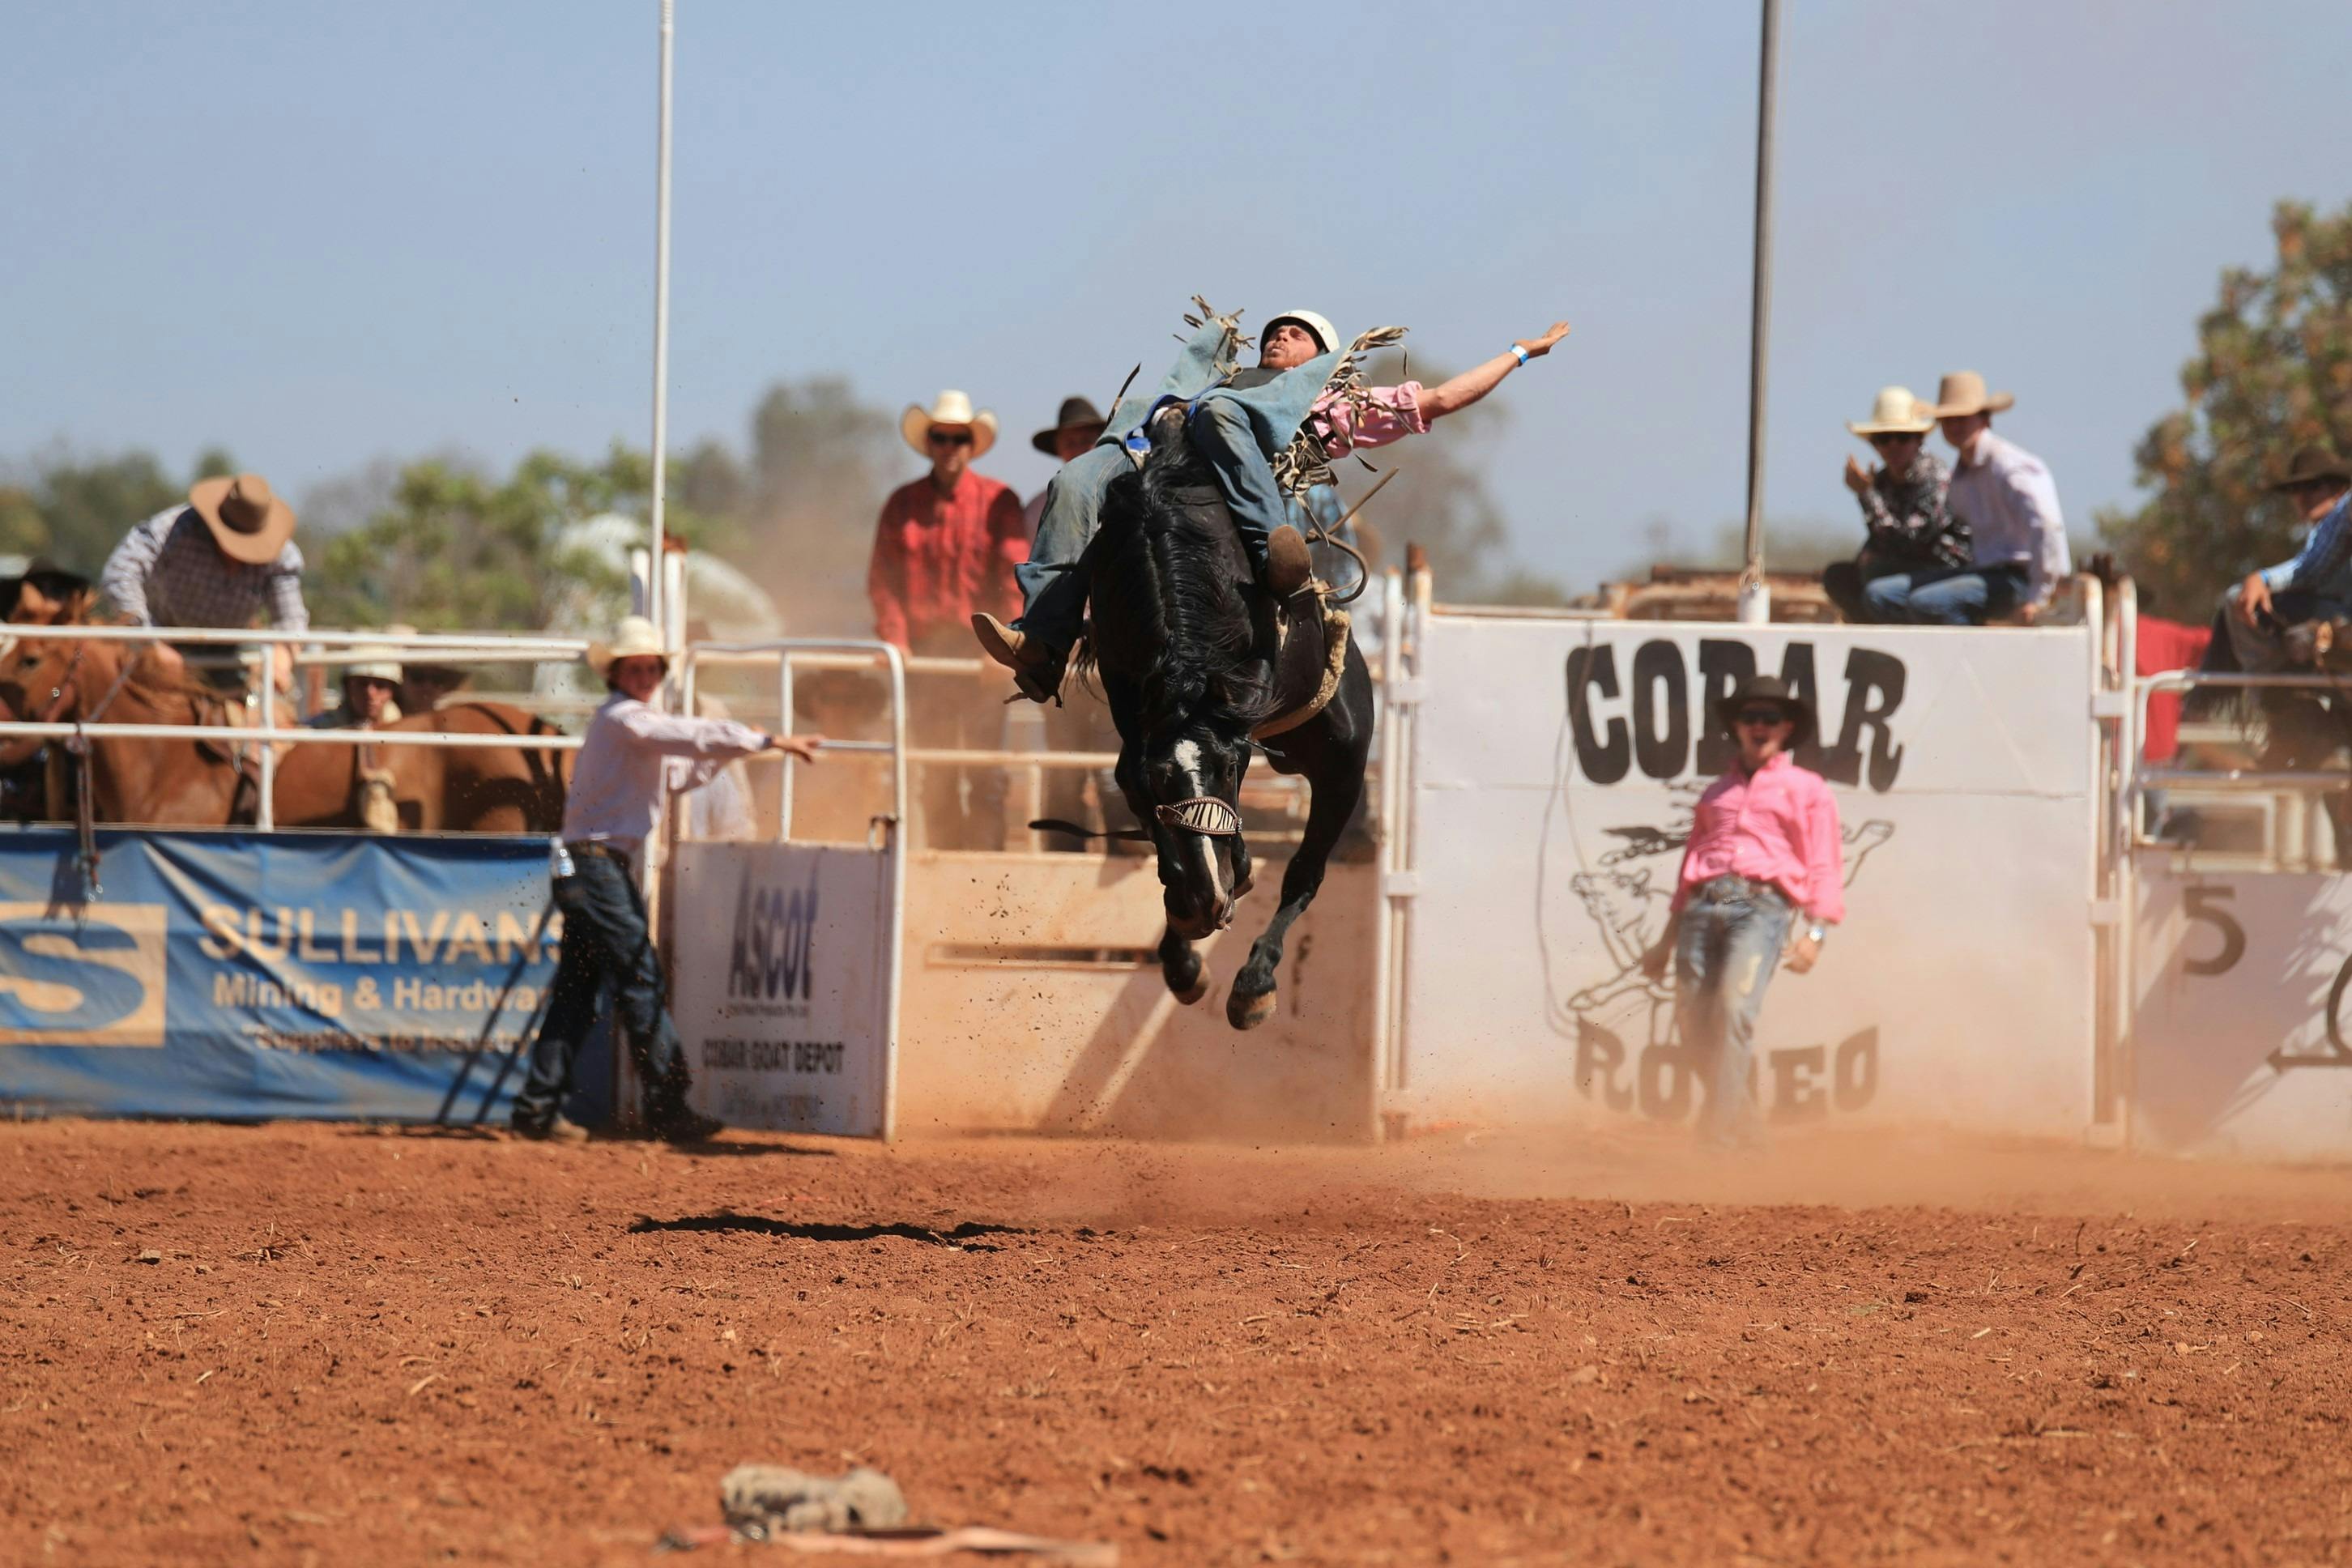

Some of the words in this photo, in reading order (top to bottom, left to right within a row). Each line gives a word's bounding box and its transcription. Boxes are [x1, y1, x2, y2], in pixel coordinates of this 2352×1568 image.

[2184, 885, 2247, 978] 5
[213, 972, 342, 1017] Mining
[353, 976, 381, 1009] &
[394, 977, 555, 1012] Hardwar
[1574, 1013, 1879, 1123] ROEO
